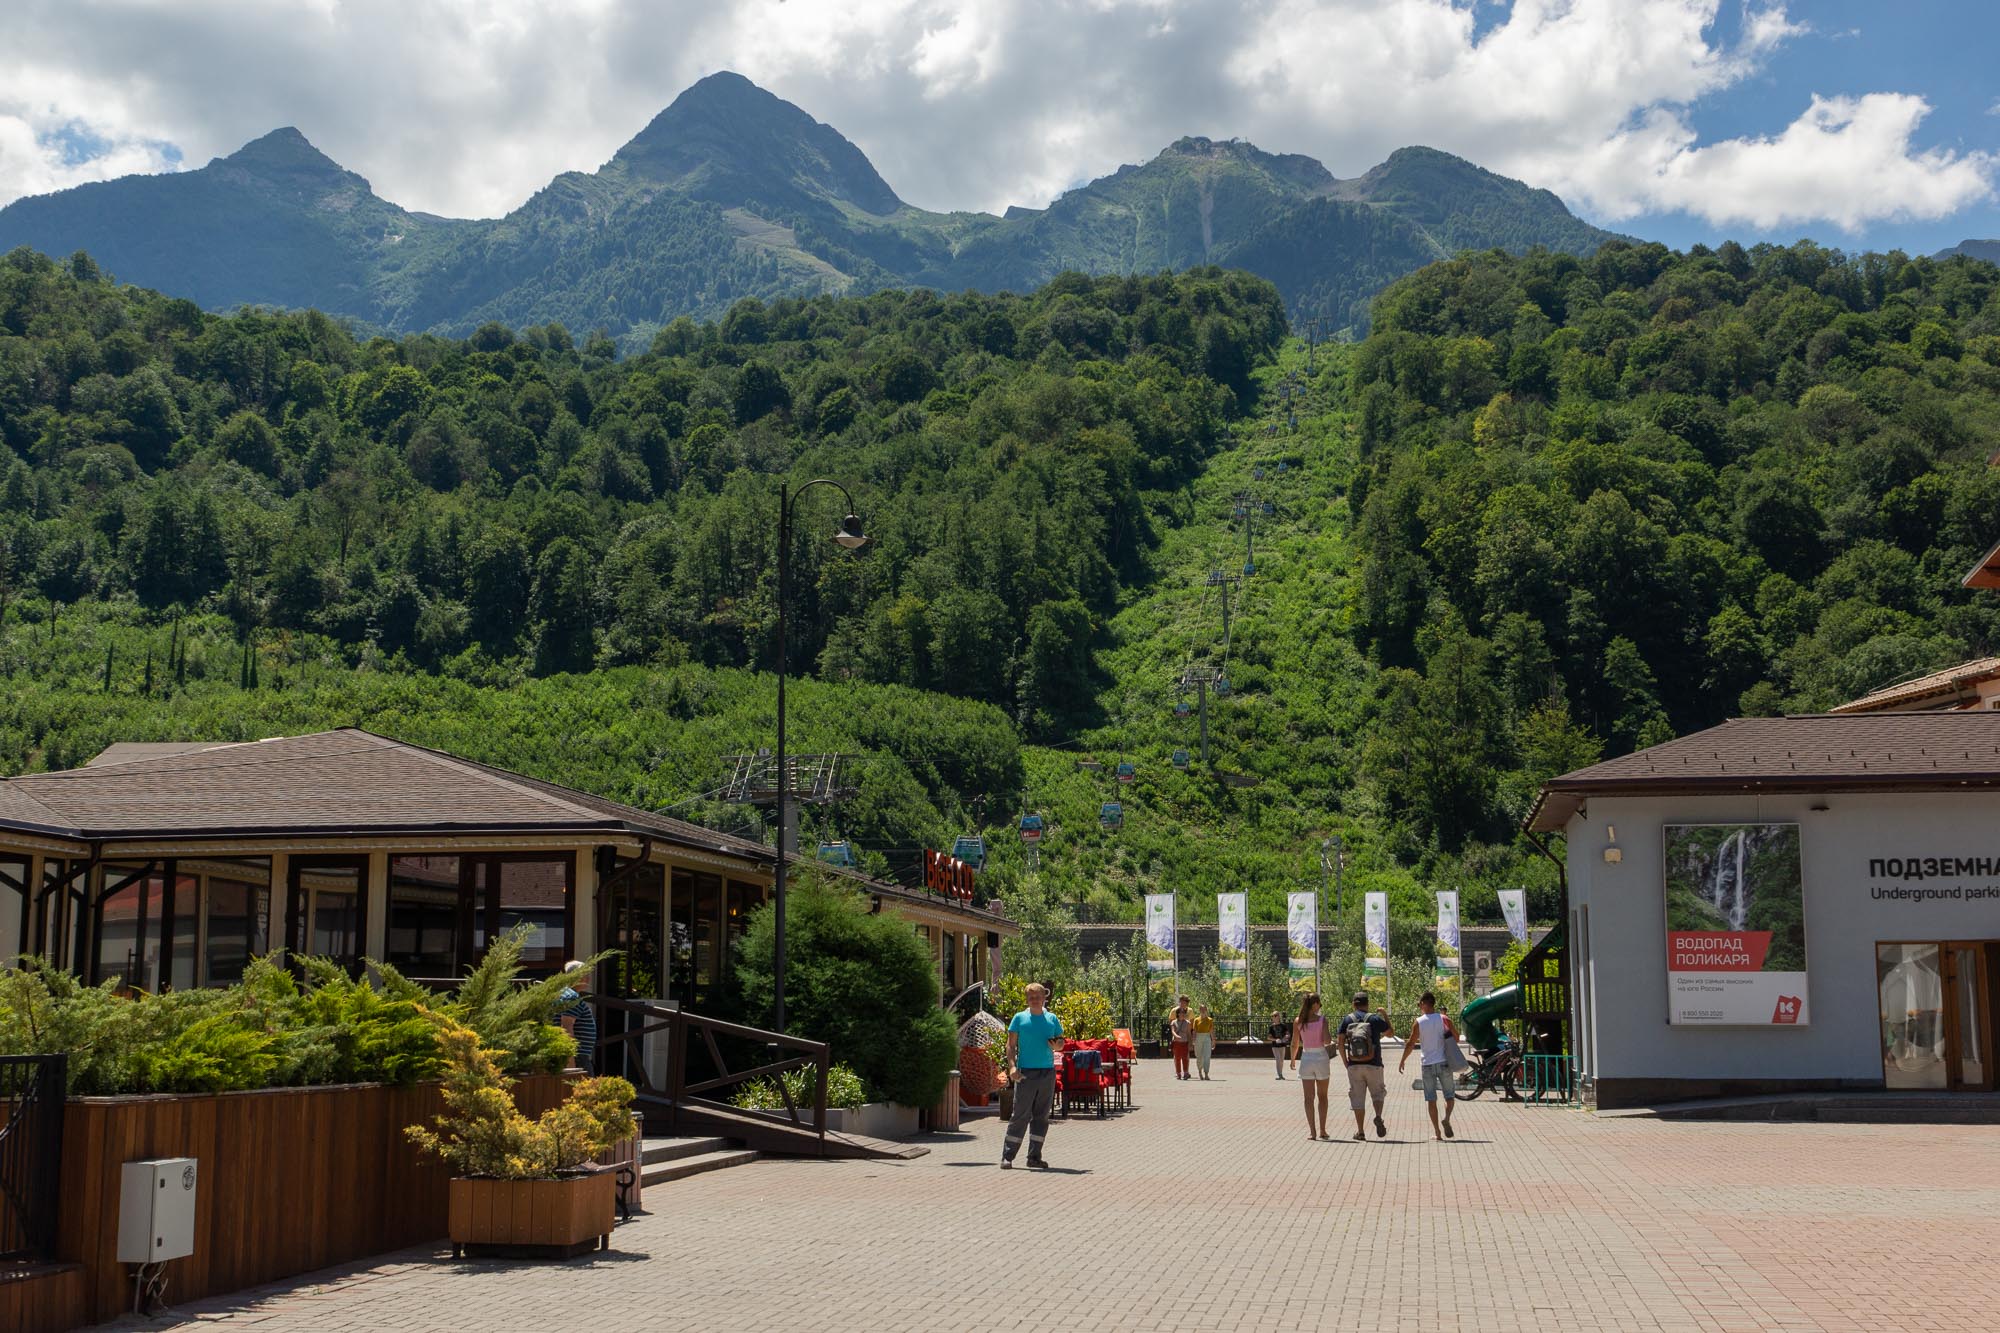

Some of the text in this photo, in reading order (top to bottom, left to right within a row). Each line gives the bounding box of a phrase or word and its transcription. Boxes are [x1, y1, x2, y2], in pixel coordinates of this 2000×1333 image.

[927, 848, 975, 900] BIGFOOD
[1871, 885, 2000, 902] Underground parki
[1676, 938, 1743, 951] ВОДОПАД
[1676, 954, 1750, 965] ПОЛИКАРЯ
